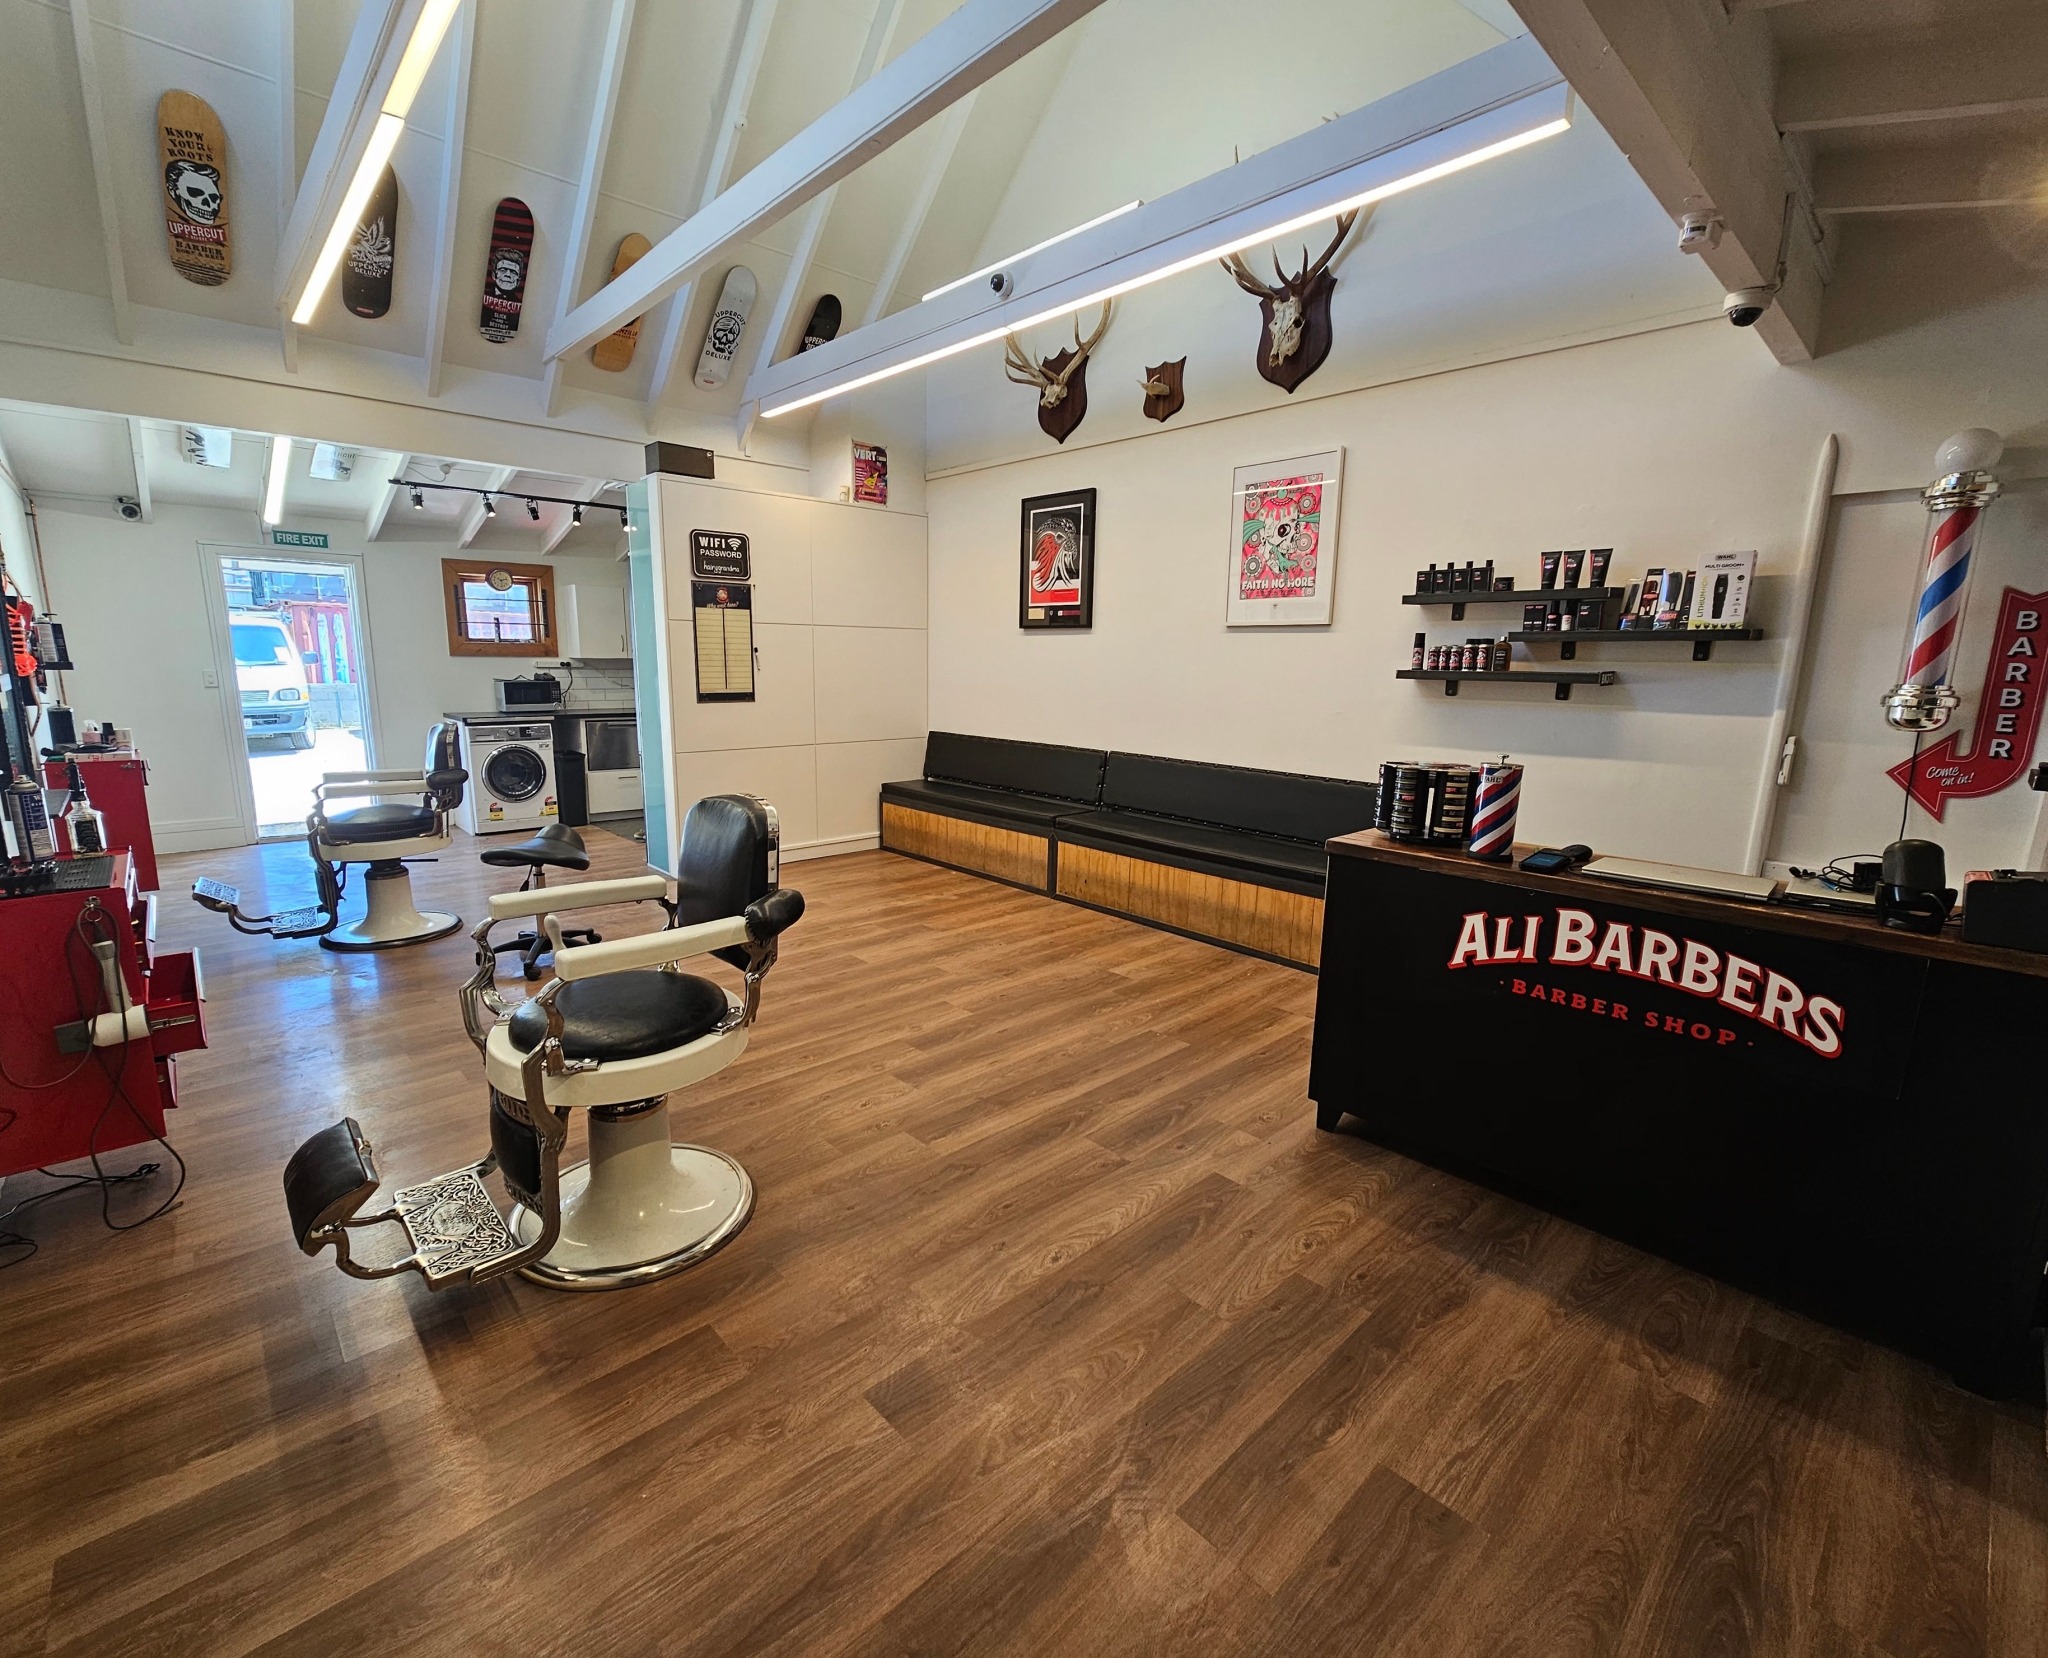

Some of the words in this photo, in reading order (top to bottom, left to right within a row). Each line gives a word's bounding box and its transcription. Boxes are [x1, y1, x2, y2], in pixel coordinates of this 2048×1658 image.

[165, 126, 204, 142] KNOW
[169, 139, 206, 152] YOUR
[167, 148, 214, 162] ROOTS
[168, 220, 224, 241] UPPERCUT
[175, 240, 223, 256] BARBER
[348, 260, 389, 275] UPPERCUT
[354, 267, 381, 278] DELUXE
[483, 294, 522, 311] UPPERCUT
[715, 309, 746, 326] UPPERCUT
[705, 350, 732, 361] DELUXE
[853, 448, 877, 461] VERT
[276, 532, 300, 545] FIRE
[302, 534, 325, 546] EXIT
[699, 536, 726, 549] WIFI
[700, 548, 742, 559] PASSWORD
[703, 560, 740, 573] hairygrandma
[1241, 579, 1269, 591] FAITH
[1271, 577, 1286, 590] NO
[1287, 576, 1315, 588] MORE
[1988, 610, 2039, 759] BARBER
[1926, 766, 1960, 779] Come
[1941, 777, 1956, 786] on
[1957, 772, 1975, 785] in!
[1447, 911, 1543, 969] ALI
[1548, 907, 1846, 1059] BARBERS
[1511, 978, 1629, 1021] BARBER
[1643, 1011, 1737, 1046] SHOP
